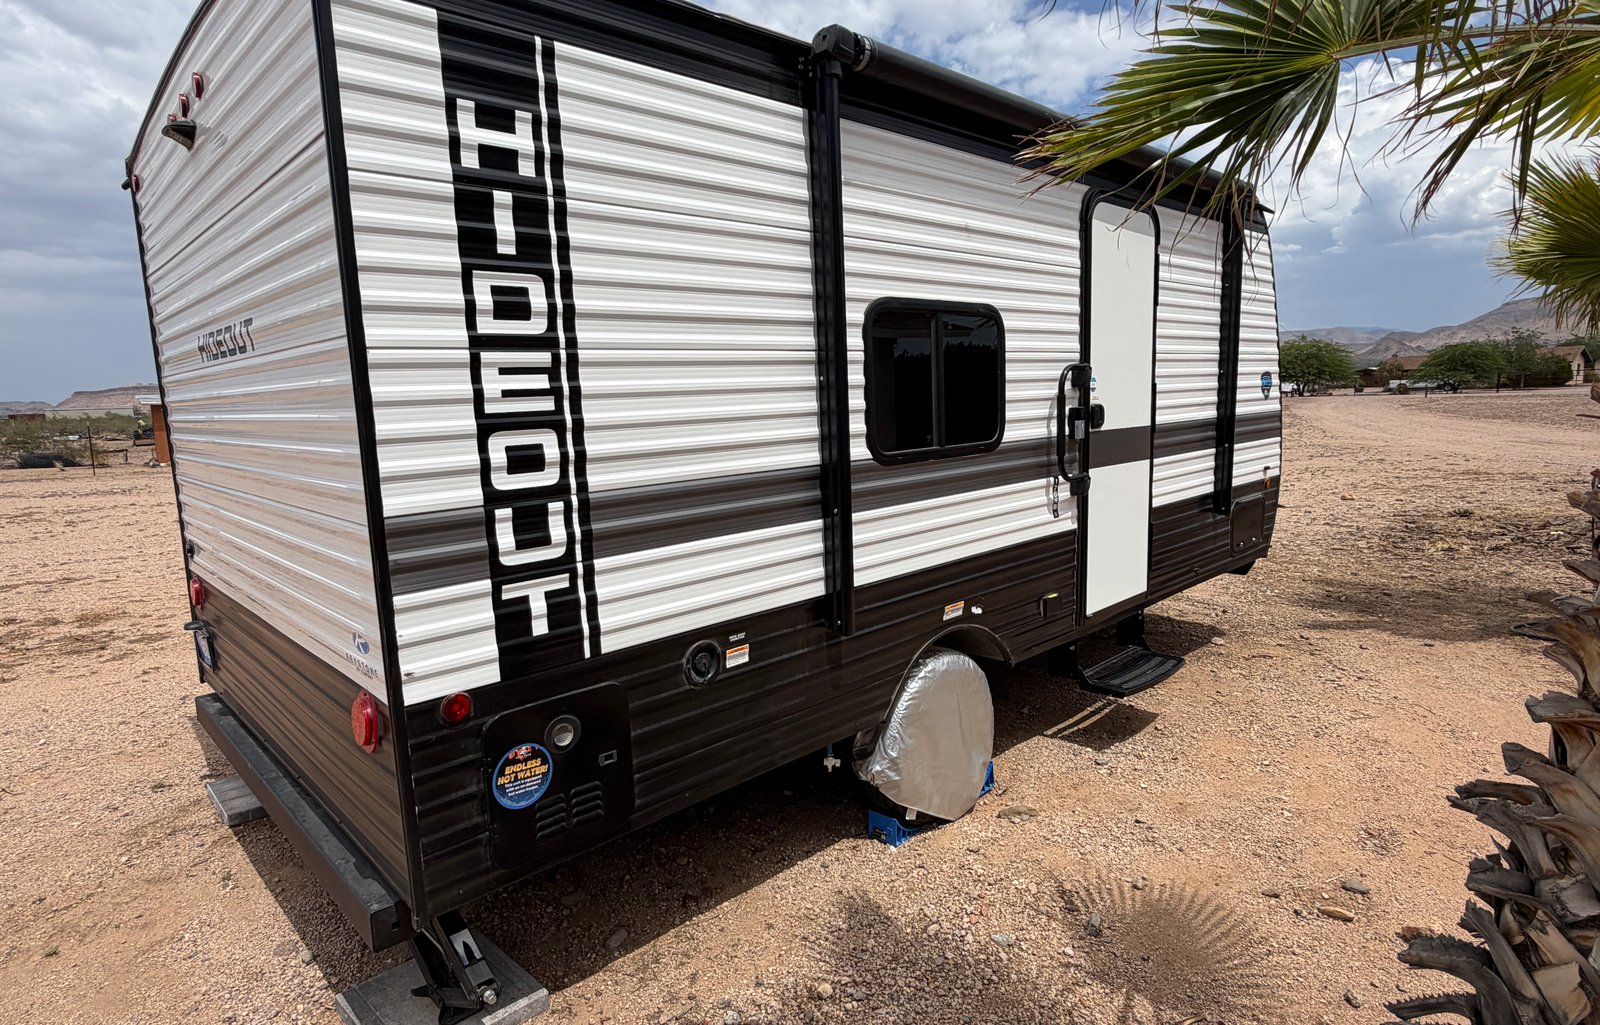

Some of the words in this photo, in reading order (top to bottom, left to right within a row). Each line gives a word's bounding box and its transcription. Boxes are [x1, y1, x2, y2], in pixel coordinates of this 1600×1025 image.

[197, 317, 255, 363] HIDEOUT
[455, 97, 570, 637] HIDEOUT
[497, 773, 516, 786] HOT
[517, 764, 548, 780] WATER!
[504, 758, 542, 774] ENDLESS
